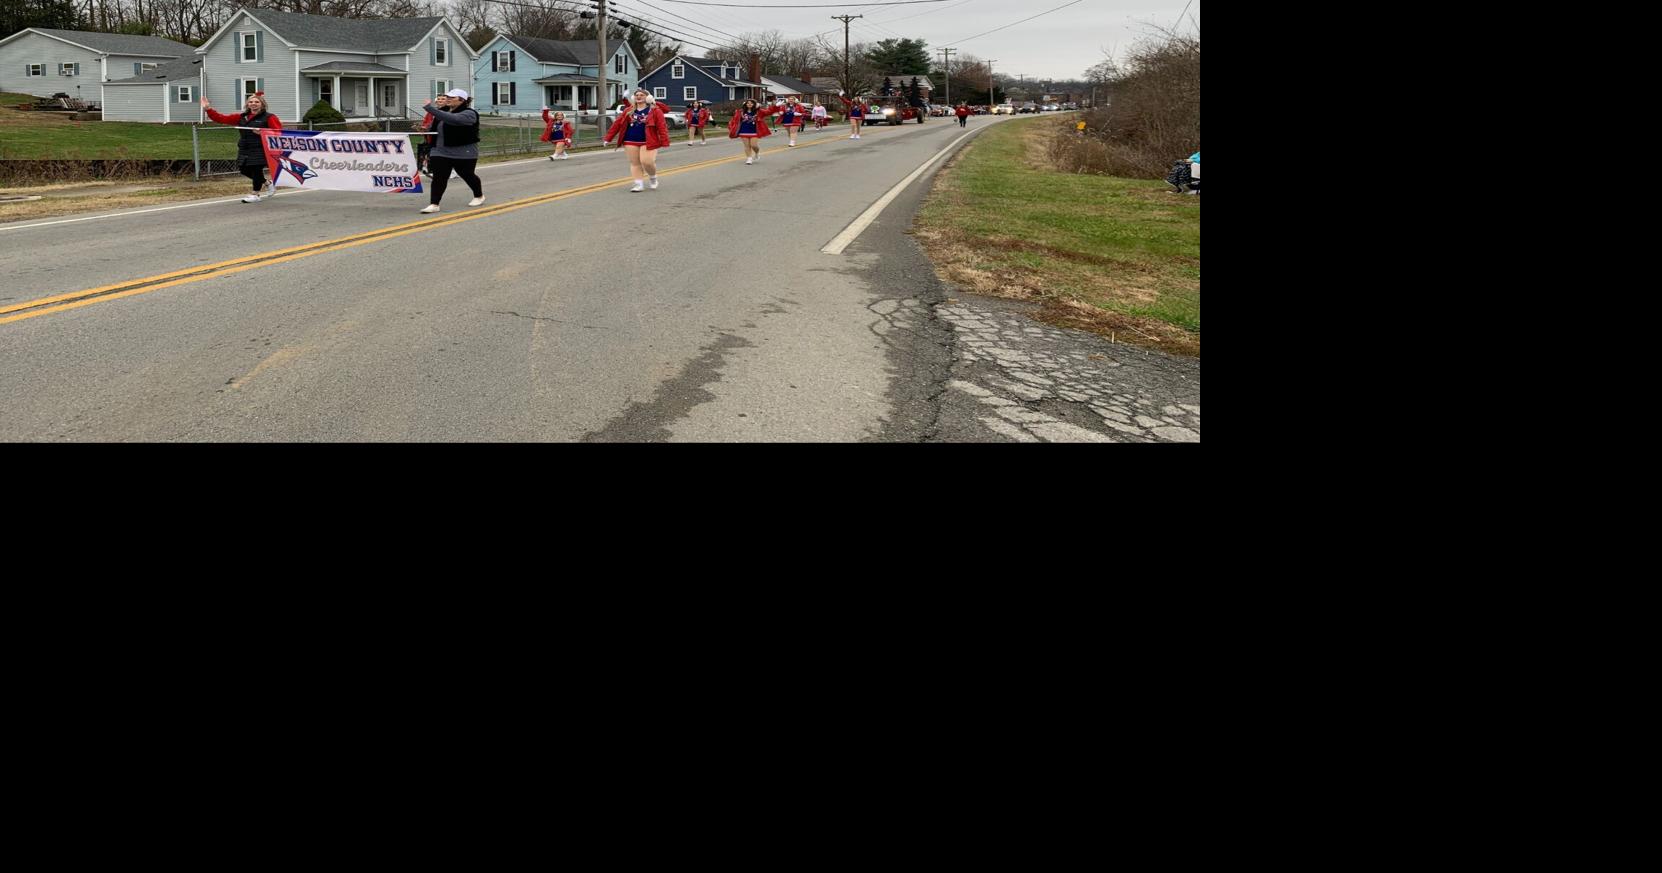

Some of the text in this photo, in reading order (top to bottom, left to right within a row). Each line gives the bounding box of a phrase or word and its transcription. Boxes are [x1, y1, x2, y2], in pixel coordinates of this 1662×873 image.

[267, 136, 405, 153] NELSON COUNTY
[309, 157, 409, 173] Cheerleaders
[372, 176, 414, 188] NCHS
